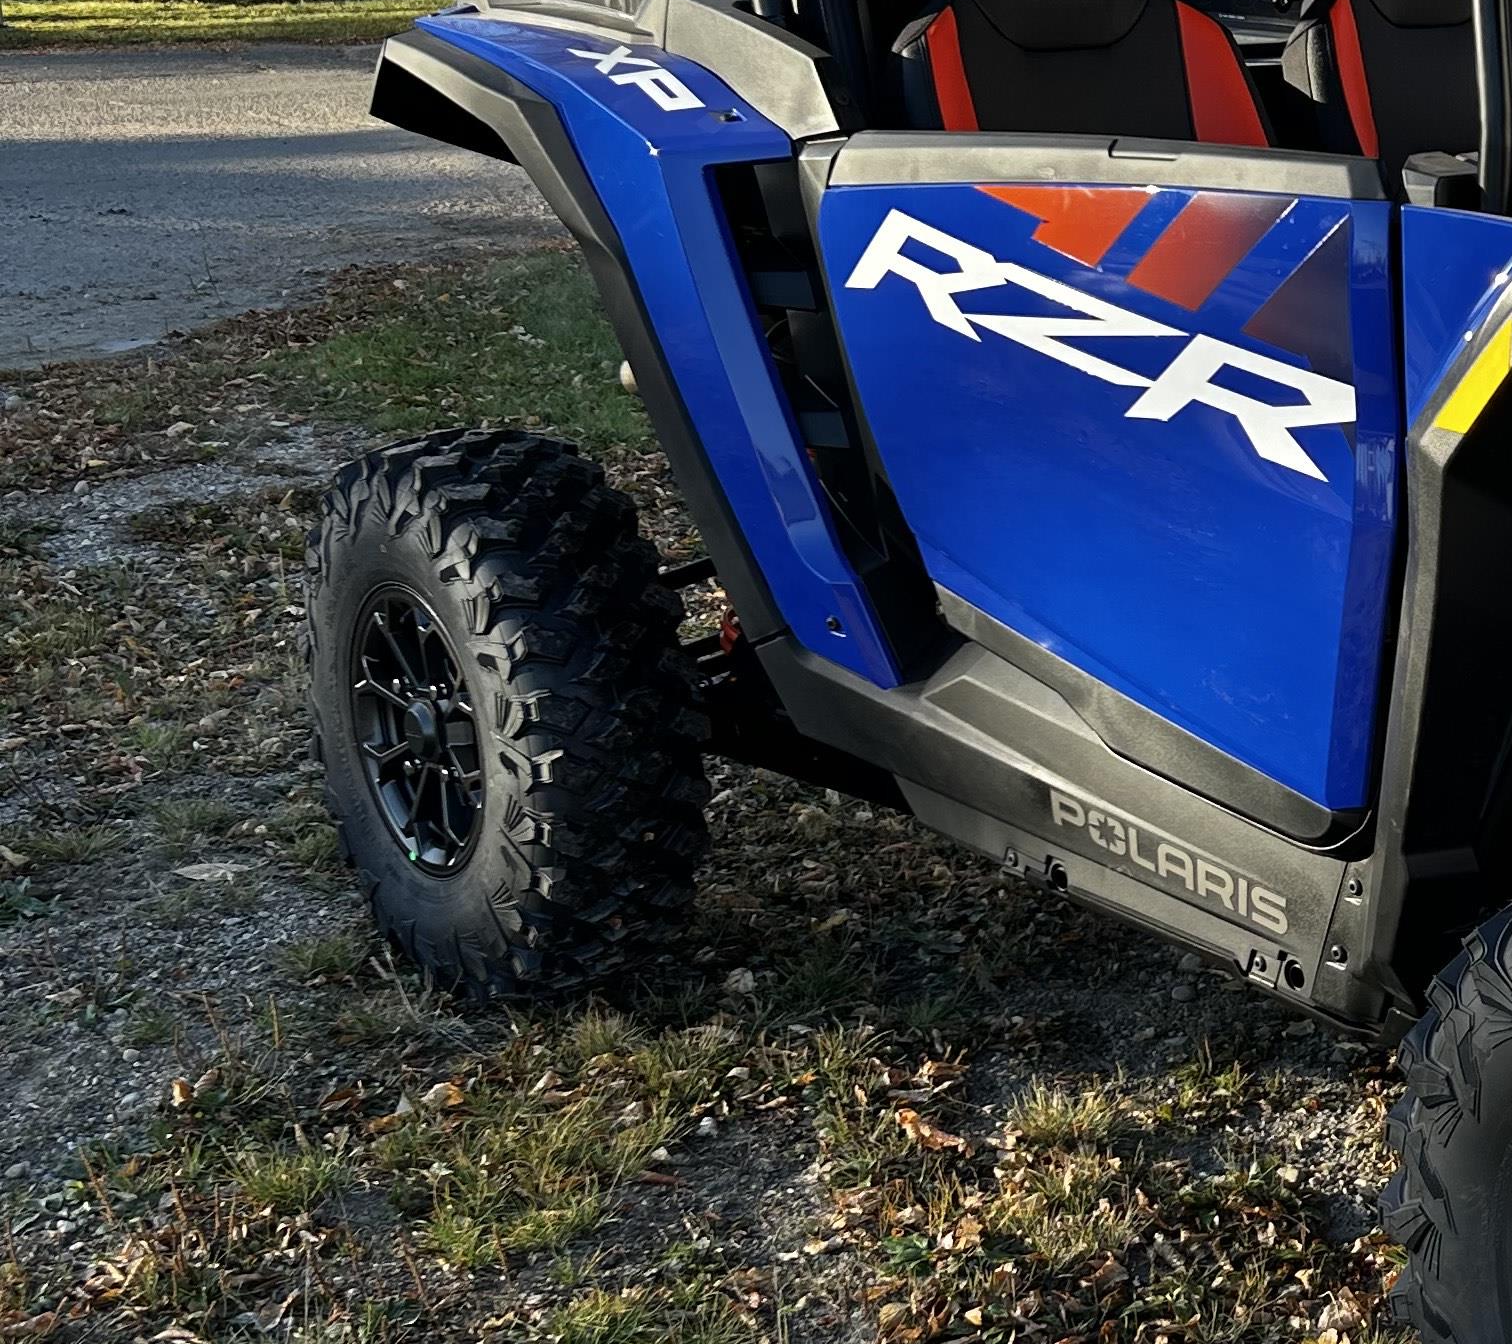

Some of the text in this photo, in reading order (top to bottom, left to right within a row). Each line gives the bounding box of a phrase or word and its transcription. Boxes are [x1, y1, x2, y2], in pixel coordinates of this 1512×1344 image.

[567, 45, 706, 111] XP
[844, 208, 1357, 482] RZR
[1049, 787, 1289, 935] POLARIS
